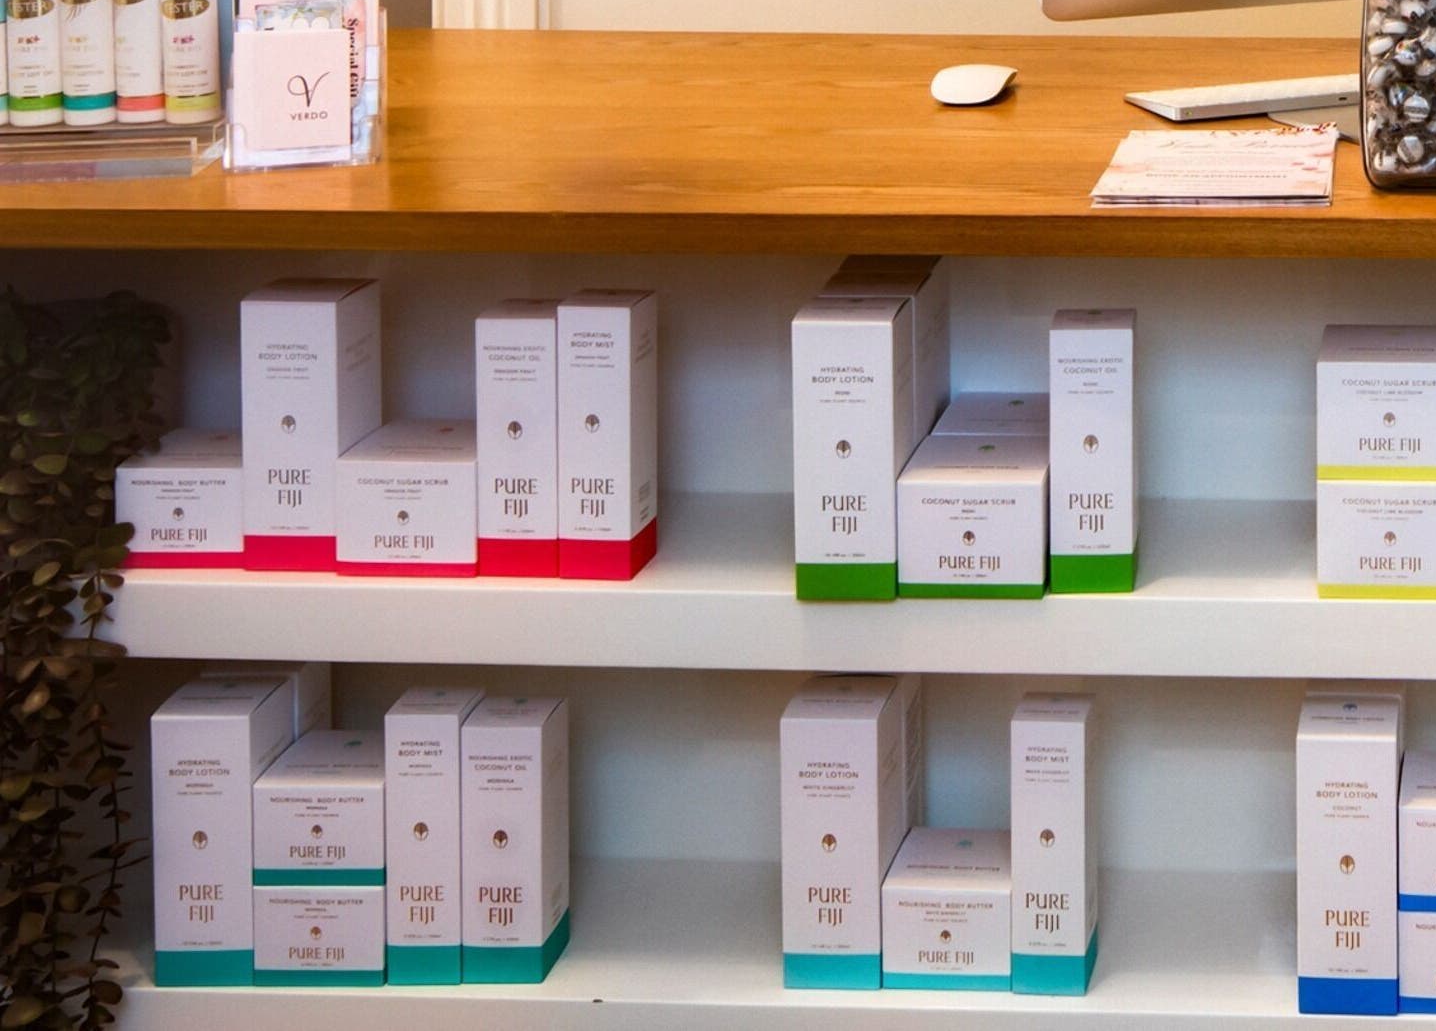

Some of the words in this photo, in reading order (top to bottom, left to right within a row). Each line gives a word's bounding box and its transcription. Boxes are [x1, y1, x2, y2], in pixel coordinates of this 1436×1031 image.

[291, 111, 328, 121] VERDO
[570, 341, 593, 349] BODY
[595, 341, 614, 349] MIST
[258, 353, 282, 361] BODY
[285, 353, 318, 361] LOTION
[488, 354, 526, 362] COCONUT
[529, 354, 541, 362] OIL
[820, 366, 864, 374] HYDRATING
[1063, 366, 1102, 375] COCONUT
[1105, 366, 1117, 375] OIL
[812, 376, 837, 384] BODY
[839, 376, 874, 384] LOTION
[1342, 379, 1382, 387] COCONUT
[1384, 379, 1409, 387] SUGAR
[1412, 379, 1436, 387] SCRUB
[1359, 438, 1395, 452] PURE
[1400, 438, 1421, 454] FIJI
[267, 469, 312, 485] PURE
[358, 478, 394, 486] COCONUT
[397, 478, 422, 486] SUGAR
[424, 478, 448, 486] SCRUB
[494, 478, 537, 495] PURE
[571, 478, 614, 495] PURE
[278, 489, 302, 508] FIJI
[822, 495, 867, 512] PURE
[921, 497, 960, 505] COCONUT
[963, 498, 989, 506] SUGAR
[991, 498, 1016, 506] SCRUB
[1069, 493, 1114, 510] PURE
[1342, 498, 1382, 506] COCONUT
[1384, 498, 1410, 506] SUGAR
[504, 499, 528, 518] FIJI
[580, 499, 605, 518] FIJI
[832, 516, 857, 535] FIJI
[1079, 514, 1105, 533] FIJI
[150, 528, 184, 541] PURE
[188, 528, 208, 543] FIJI
[374, 535, 409, 549] PURE
[414, 535, 434, 550] FIJI
[939, 555, 975, 570] PURE
[980, 556, 1001, 571] FIJI
[1359, 556, 1396, 571] PURE
[1401, 557, 1422, 573] FIJI
[1025, 755, 1048, 763] BODY
[1050, 755, 1069, 764] MIST
[799, 771, 823, 779] BODY
[825, 771, 859, 779] LOTION
[1325, 781, 1369, 789] HYDRATING
[1343, 791, 1378, 799] LOTION
[289, 846, 323, 859] PURE
[327, 846, 346, 860] FIJI
[179, 884, 224, 901] PURE
[399, 886, 444, 902] PURE
[479, 887, 522, 903] PURE
[808, 887, 852, 904] PURE
[898, 900, 941, 909] NOURISHING
[967, 902, 993, 910] BUTTER
[1025, 892, 1069, 910] PURE
[189, 906, 214, 924] FIJI
[410, 906, 435, 925] FIJI
[488, 907, 514, 926] FIJI
[818, 907, 843, 926] FIJI
[1325, 909, 1370, 927] PURE
[1035, 914, 1060, 933] FIJI
[1335, 931, 1361, 950] FIJI
[288, 947, 322, 960] PURE
[326, 947, 345, 961] FIJI
[918, 950, 951, 963] PURE
[956, 950, 975, 965] FIJI
